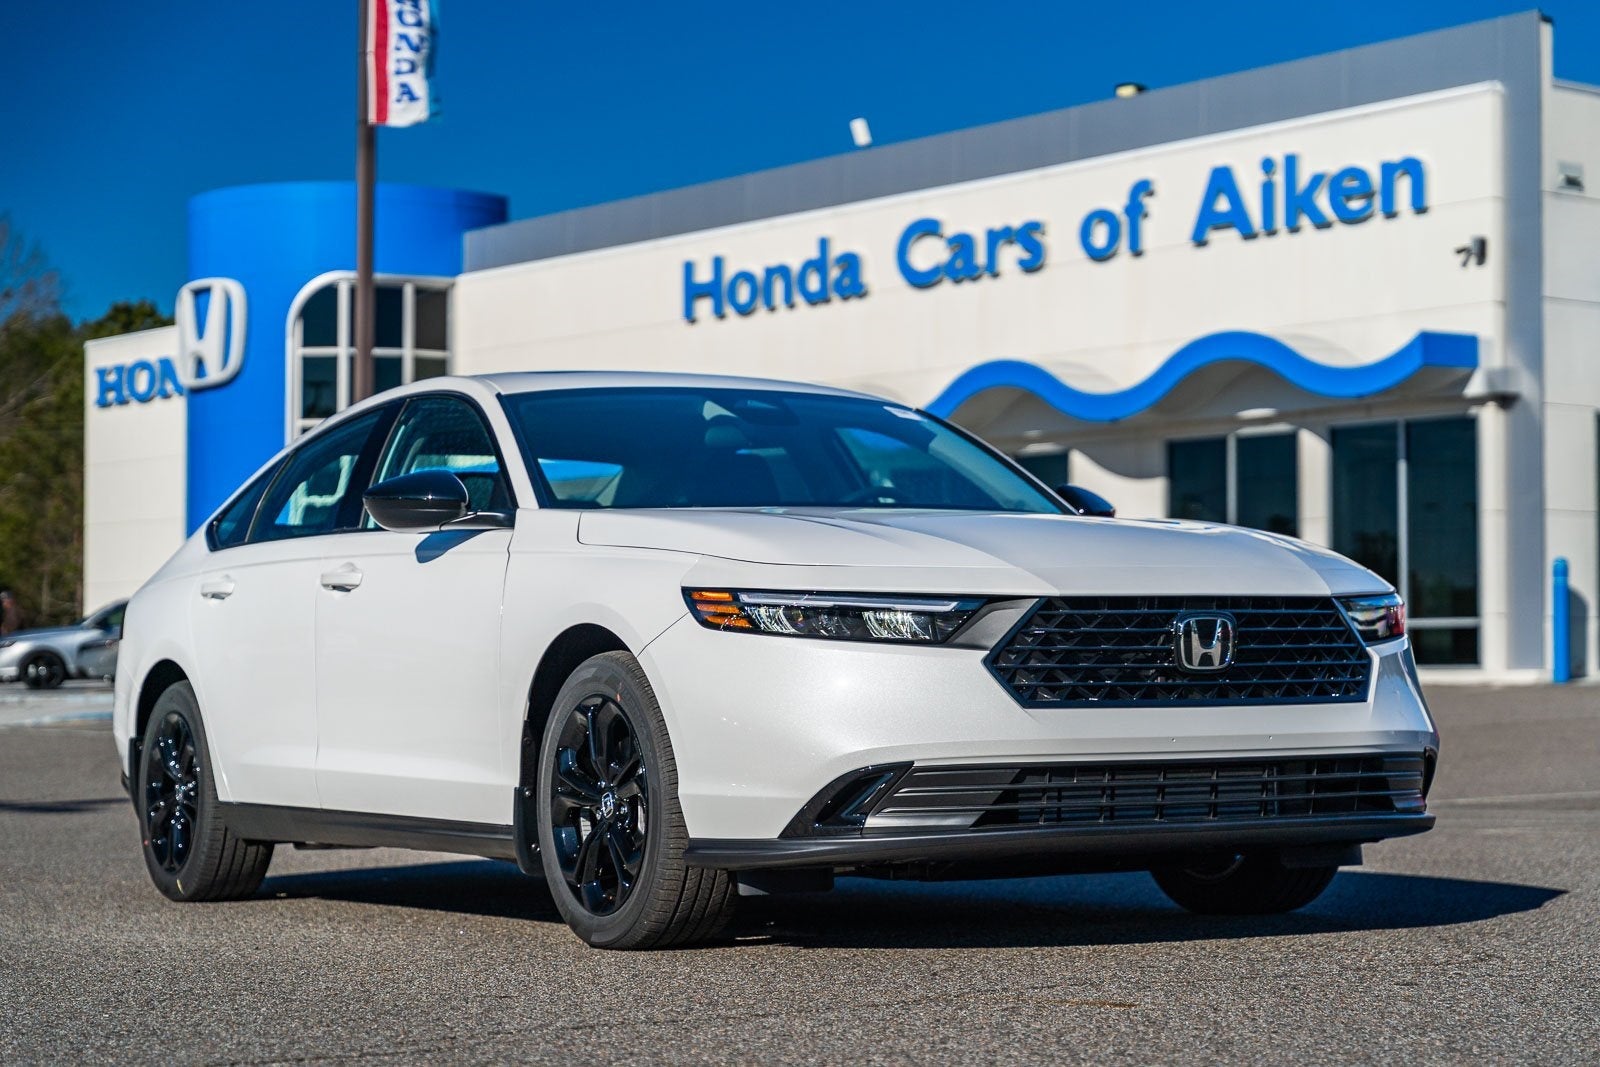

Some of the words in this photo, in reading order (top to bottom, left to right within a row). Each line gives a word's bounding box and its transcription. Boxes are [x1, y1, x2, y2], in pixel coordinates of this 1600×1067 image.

[683, 236, 867, 323] Honda
[896, 217, 1044, 289] Cars
[1079, 178, 1155, 262] of
[1190, 153, 1428, 247] Aiken
